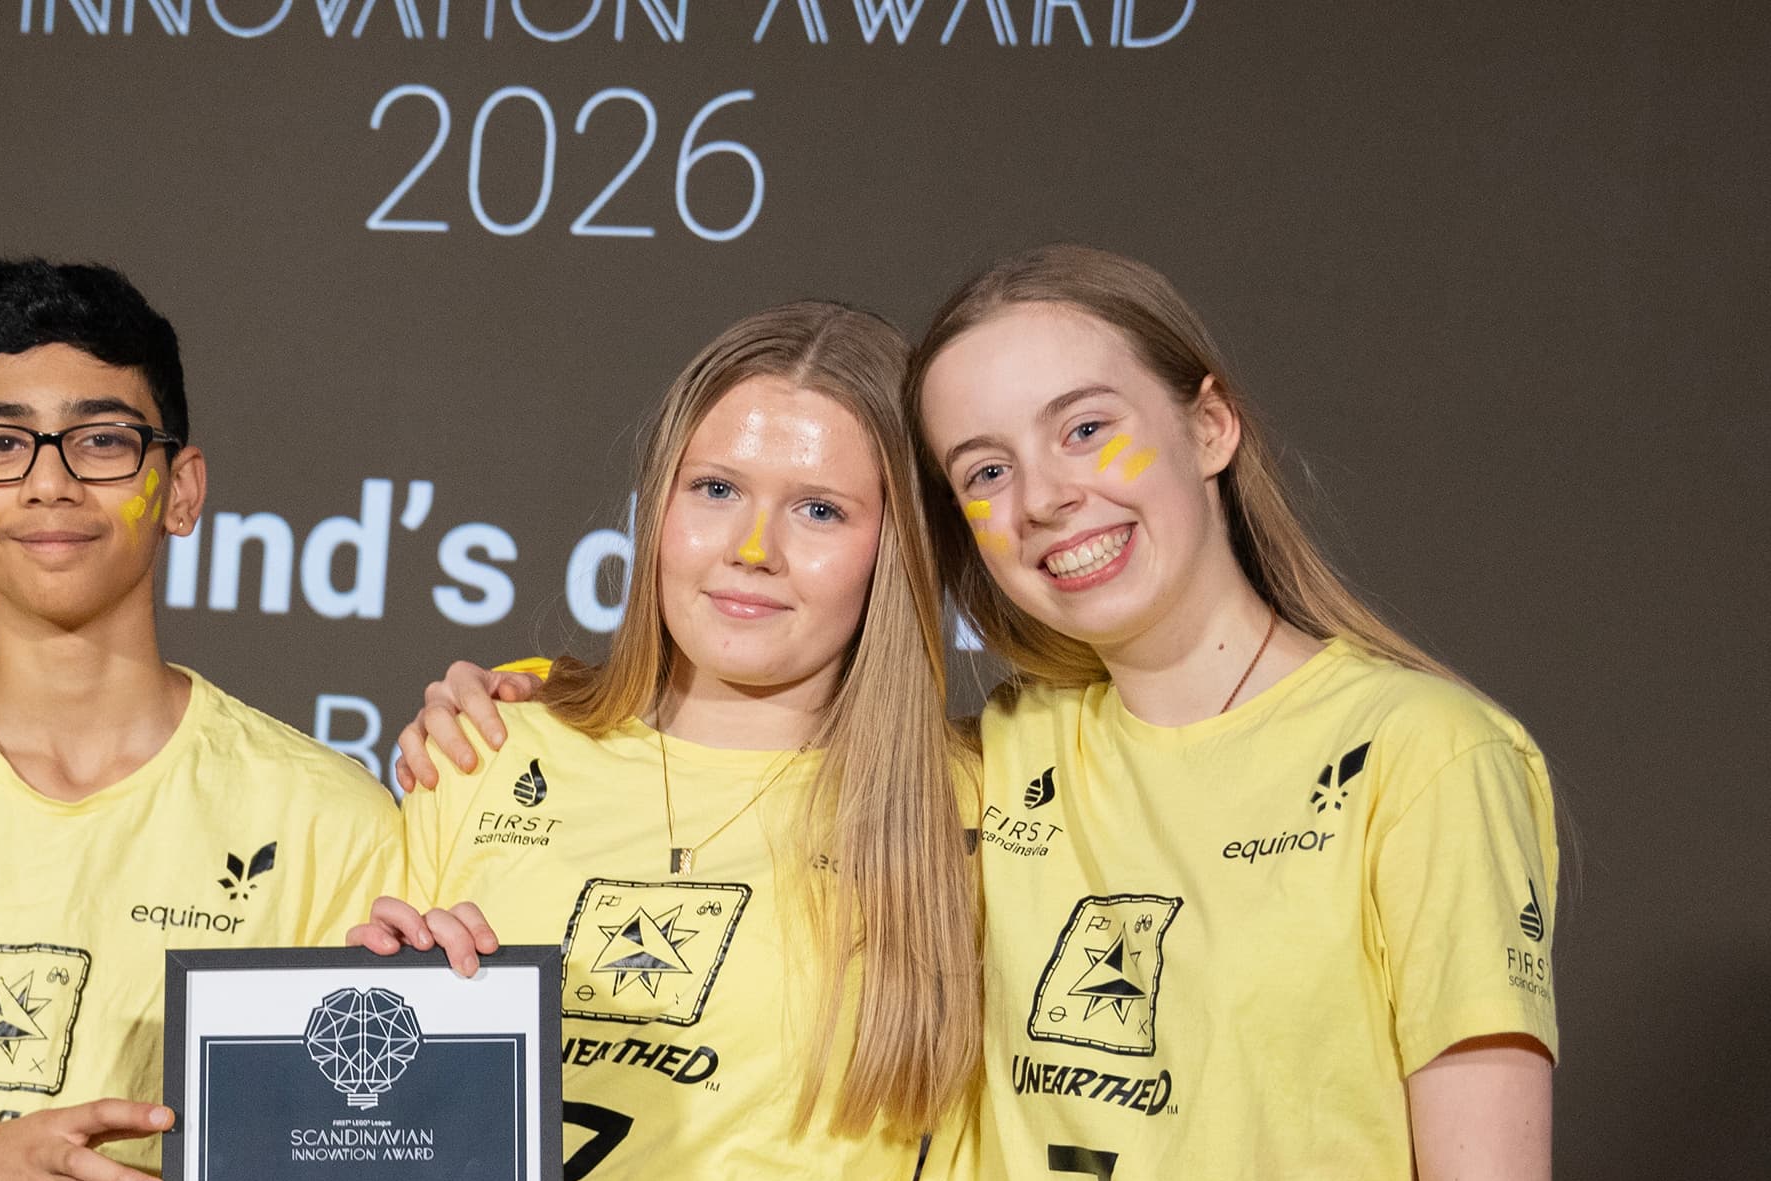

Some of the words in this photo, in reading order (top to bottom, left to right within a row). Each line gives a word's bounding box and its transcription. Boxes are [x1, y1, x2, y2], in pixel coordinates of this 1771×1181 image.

[366, 84, 765, 241] 2026
[478, 811, 563, 833] FIRST
[982, 805, 1064, 842] FIRST
[473, 831, 550, 846] scandinavia
[981, 830, 1049, 856] candinavia
[1222, 830, 1336, 864] equinor
[130, 905, 245, 934] equinor
[290, 1129, 434, 1147] SCANDINAVIAN
[291, 1148, 377, 1161] INNOVATION
[382, 1147, 435, 1161] AWARD
